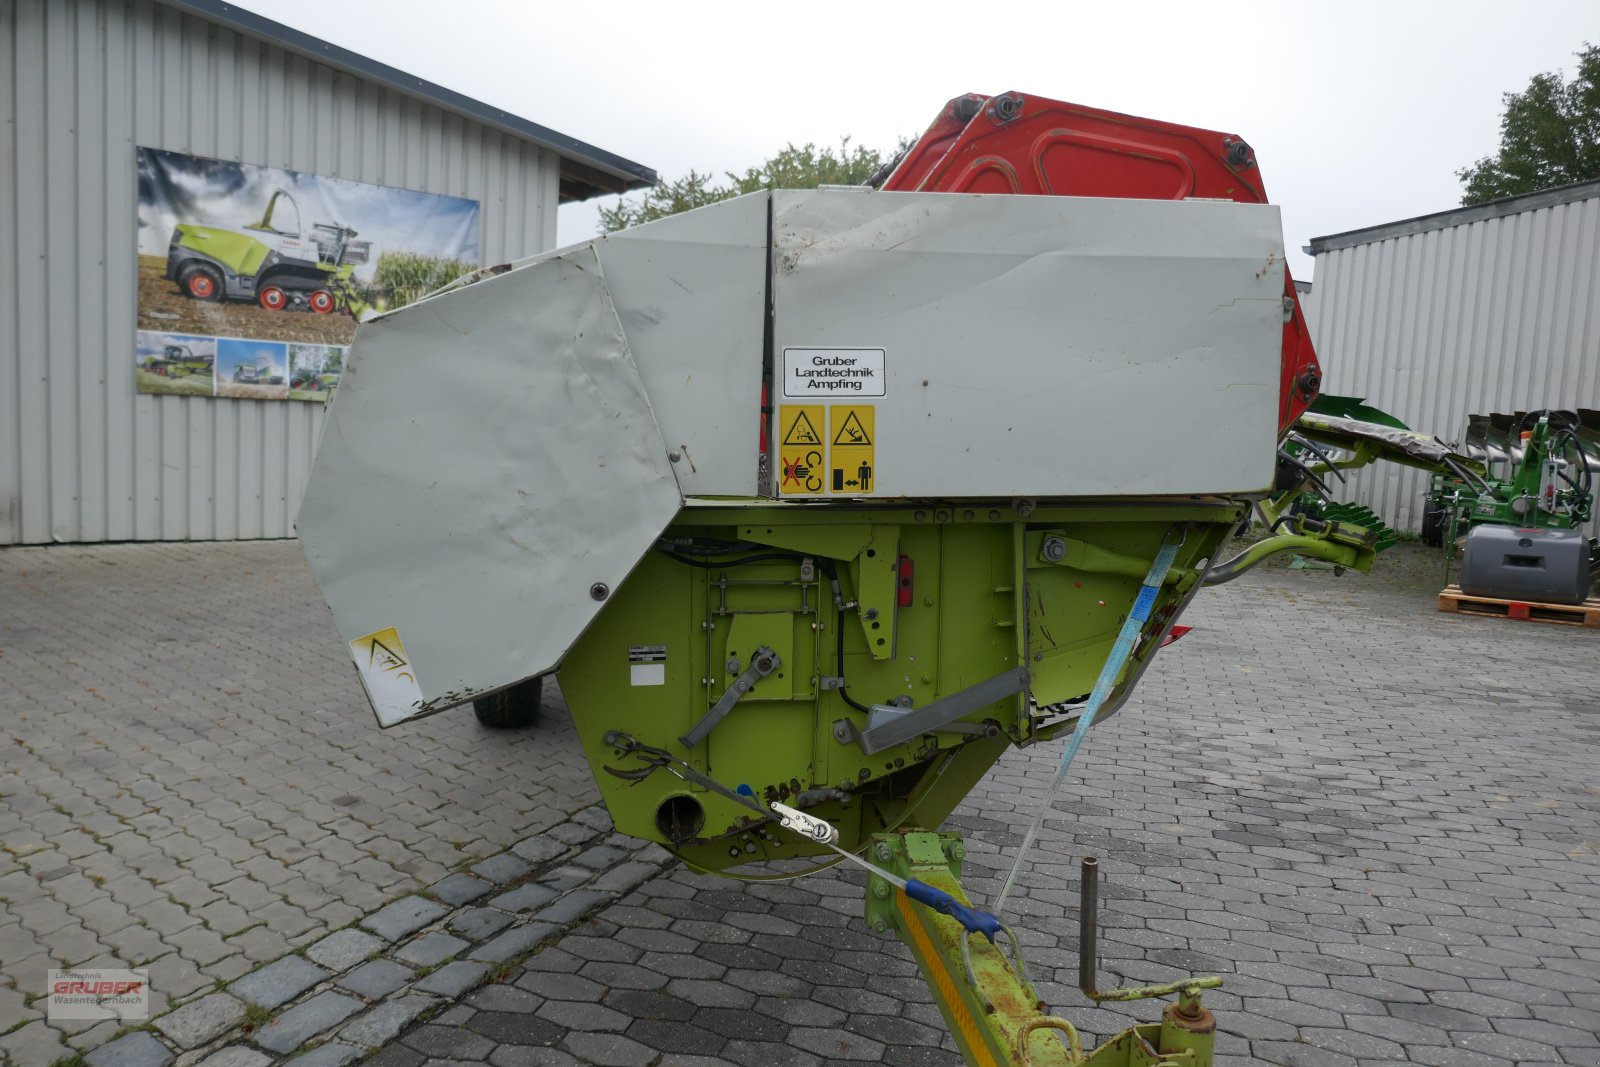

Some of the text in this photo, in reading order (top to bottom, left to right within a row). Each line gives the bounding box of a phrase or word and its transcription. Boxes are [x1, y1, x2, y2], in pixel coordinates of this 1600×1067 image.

[812, 356, 857, 366] Gruber
[795, 368, 874, 378] Landtechnik
[807, 379, 862, 390] Ampfing
